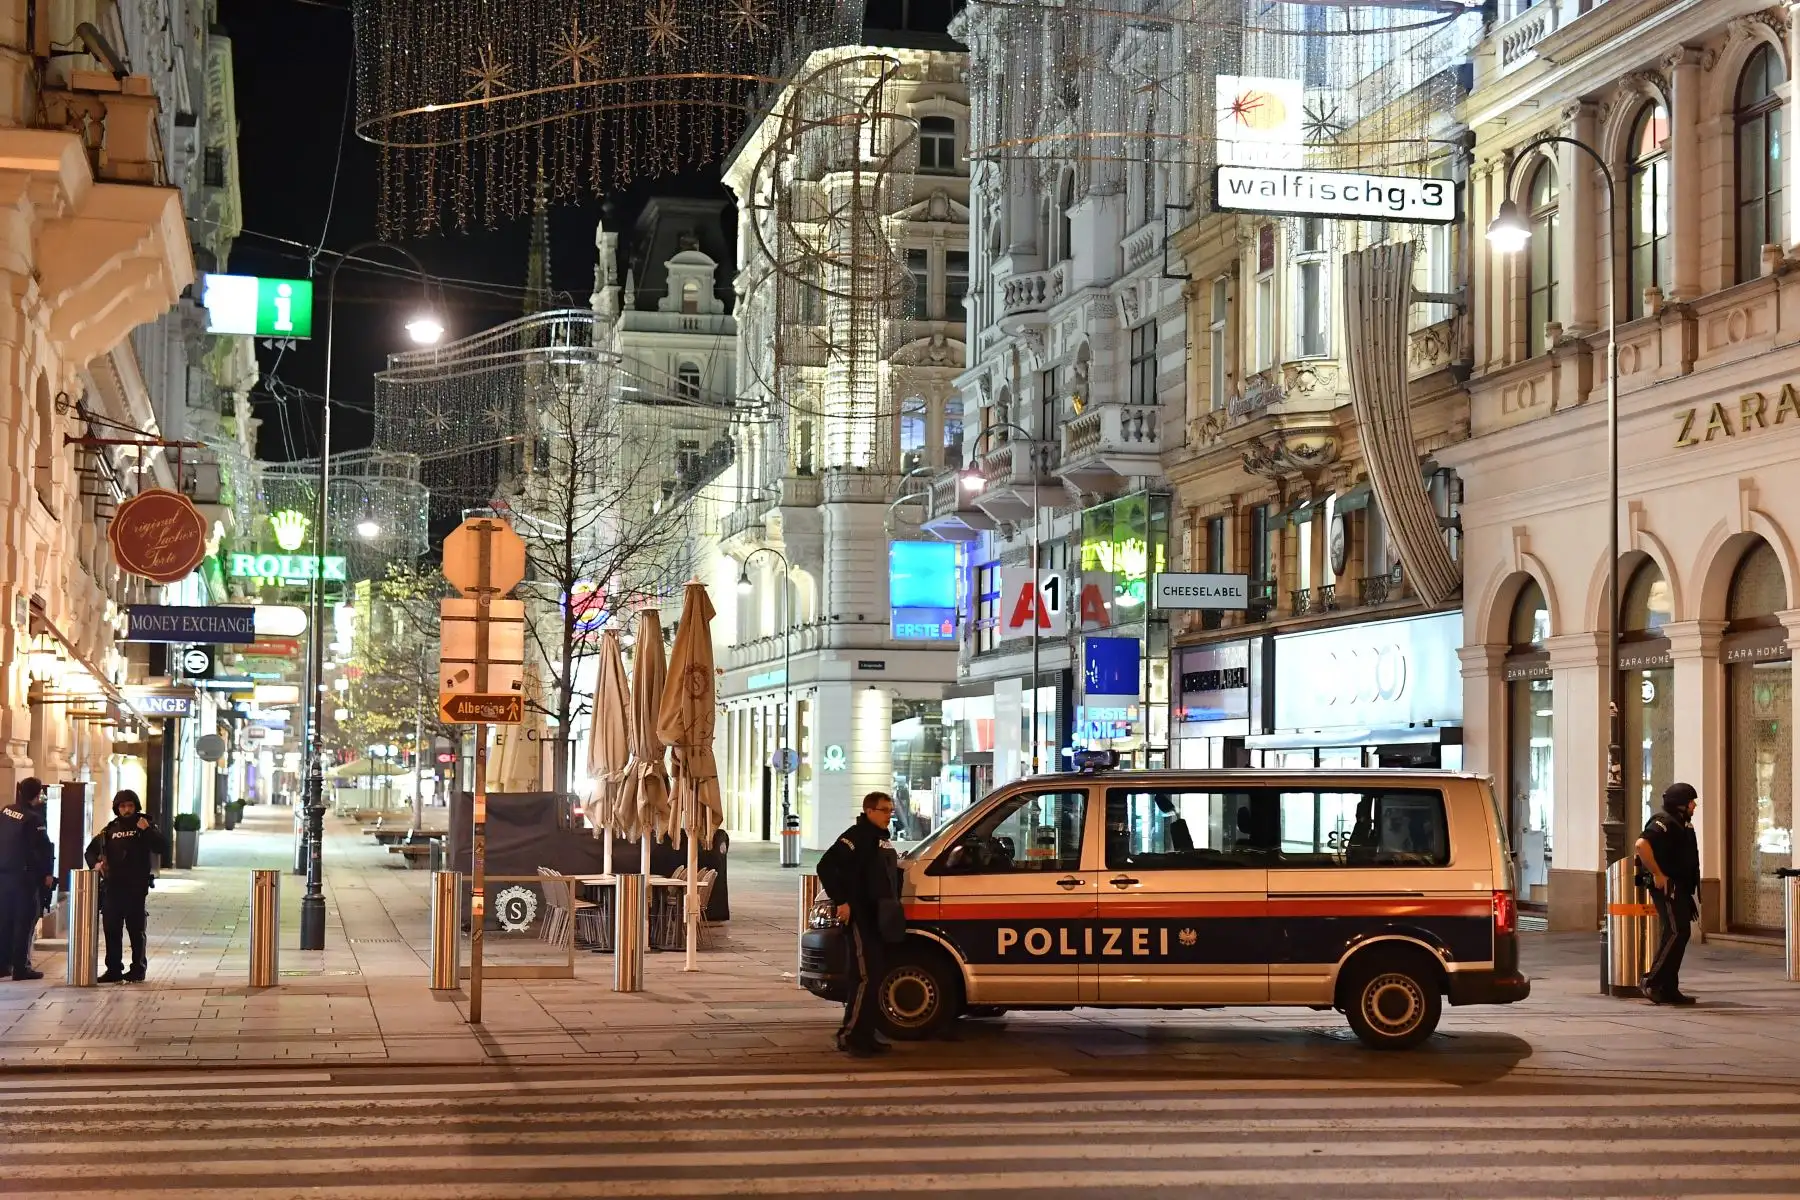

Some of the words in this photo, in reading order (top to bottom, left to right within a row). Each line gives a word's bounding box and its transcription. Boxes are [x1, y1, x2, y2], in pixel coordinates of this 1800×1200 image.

[1229, 175, 1443, 211] walfischg.3
[274, 283, 293, 331] i
[1673, 384, 1800, 448] ZARA
[142, 544, 176, 568] Torte
[233, 554, 346, 579] ROLEX
[1009, 575, 1059, 628] A1
[1163, 586, 1242, 598] CHEESELABEL
[131, 615, 179, 631] MONEY
[182, 616, 253, 634] EXCHANGE
[896, 623, 940, 637] ERSTE
[1620, 656, 1643, 667] ZARA
[1645, 654, 1670, 665] HOME
[1728, 649, 1753, 660] ZARA
[1757, 646, 1785, 656] HOME
[1508, 669, 1527, 678] ZARA
[1529, 667, 1549, 676] HOME
[3, 807, 24, 820] POLIZEI
[511, 902, 523, 920] S
[998, 928, 1169, 955] POLIZEI
